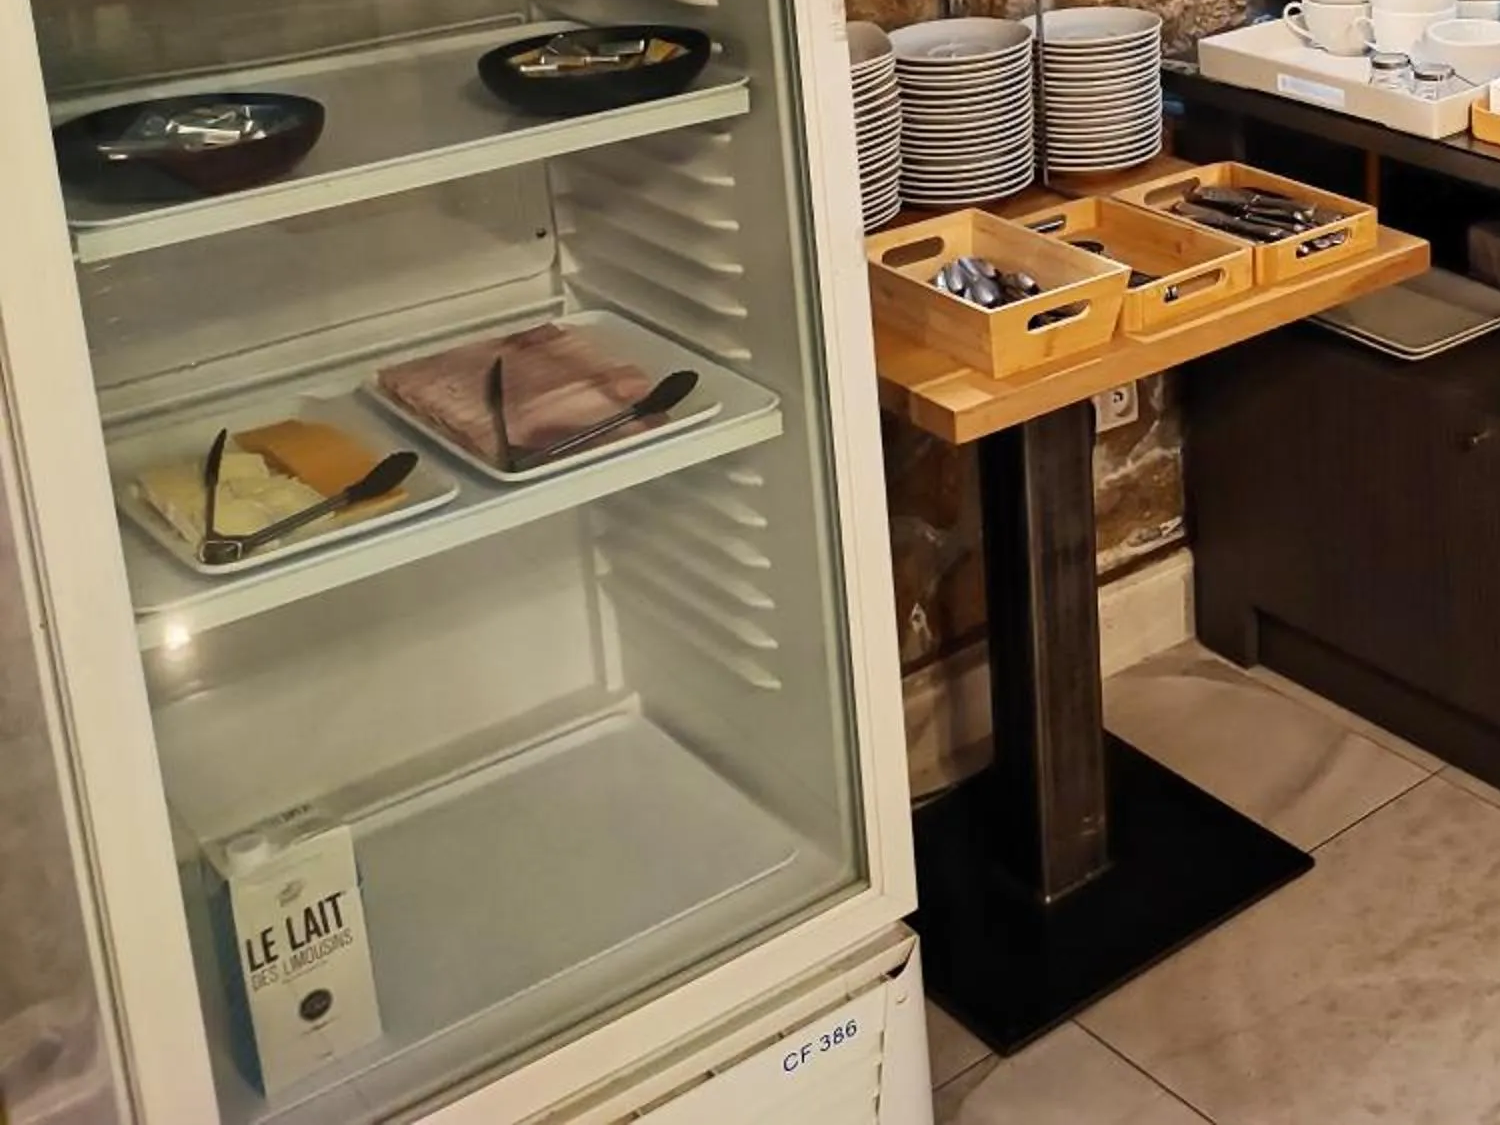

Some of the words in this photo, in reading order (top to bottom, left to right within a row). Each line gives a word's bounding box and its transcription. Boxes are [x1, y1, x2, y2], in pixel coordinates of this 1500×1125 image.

[246, 926, 279, 972] LE
[285, 891, 346, 952] LAIT
[250, 963, 279, 993] DES
[282, 928, 353, 976] LIMOUSINS
[783, 1043, 813, 1072] CF
[819, 1019, 857, 1052] 386
